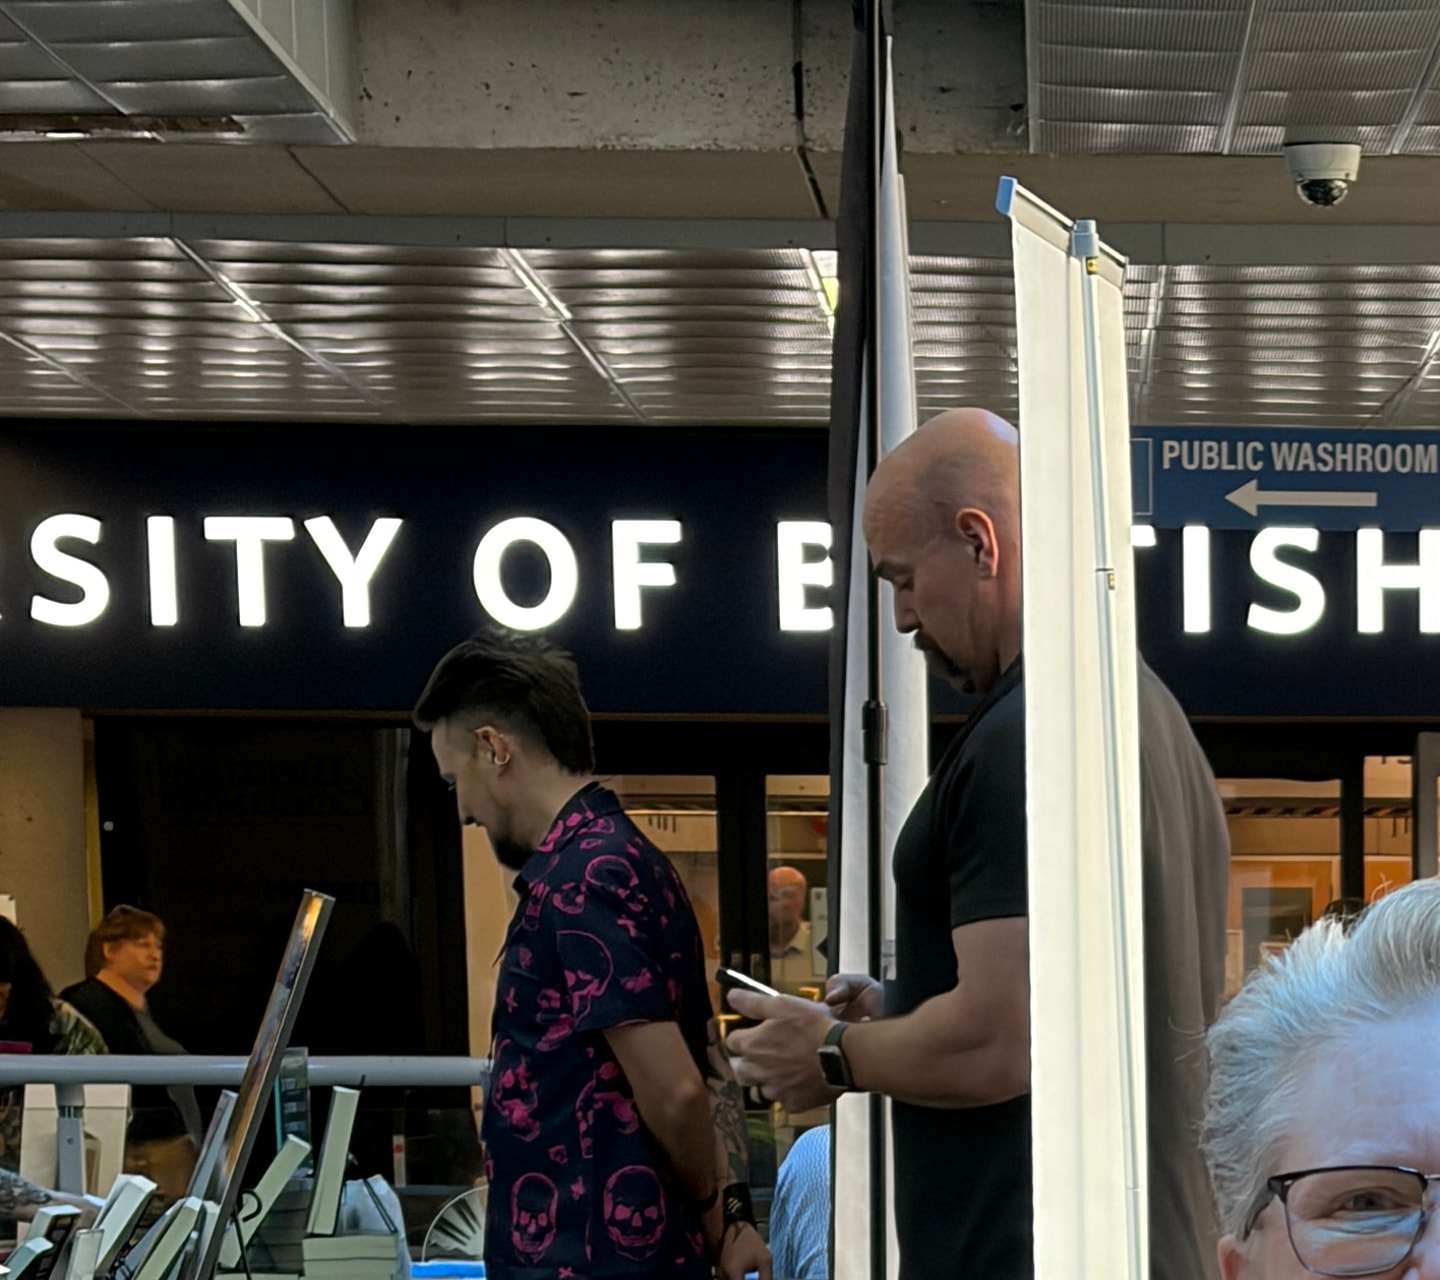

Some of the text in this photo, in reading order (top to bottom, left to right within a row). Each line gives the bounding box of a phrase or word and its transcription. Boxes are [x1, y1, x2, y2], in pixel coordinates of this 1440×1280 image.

[1161, 440, 1438, 474] PUBLIC WASHROOM
[0, 514, 402, 627] SITY
[473, 517, 682, 631] OF
